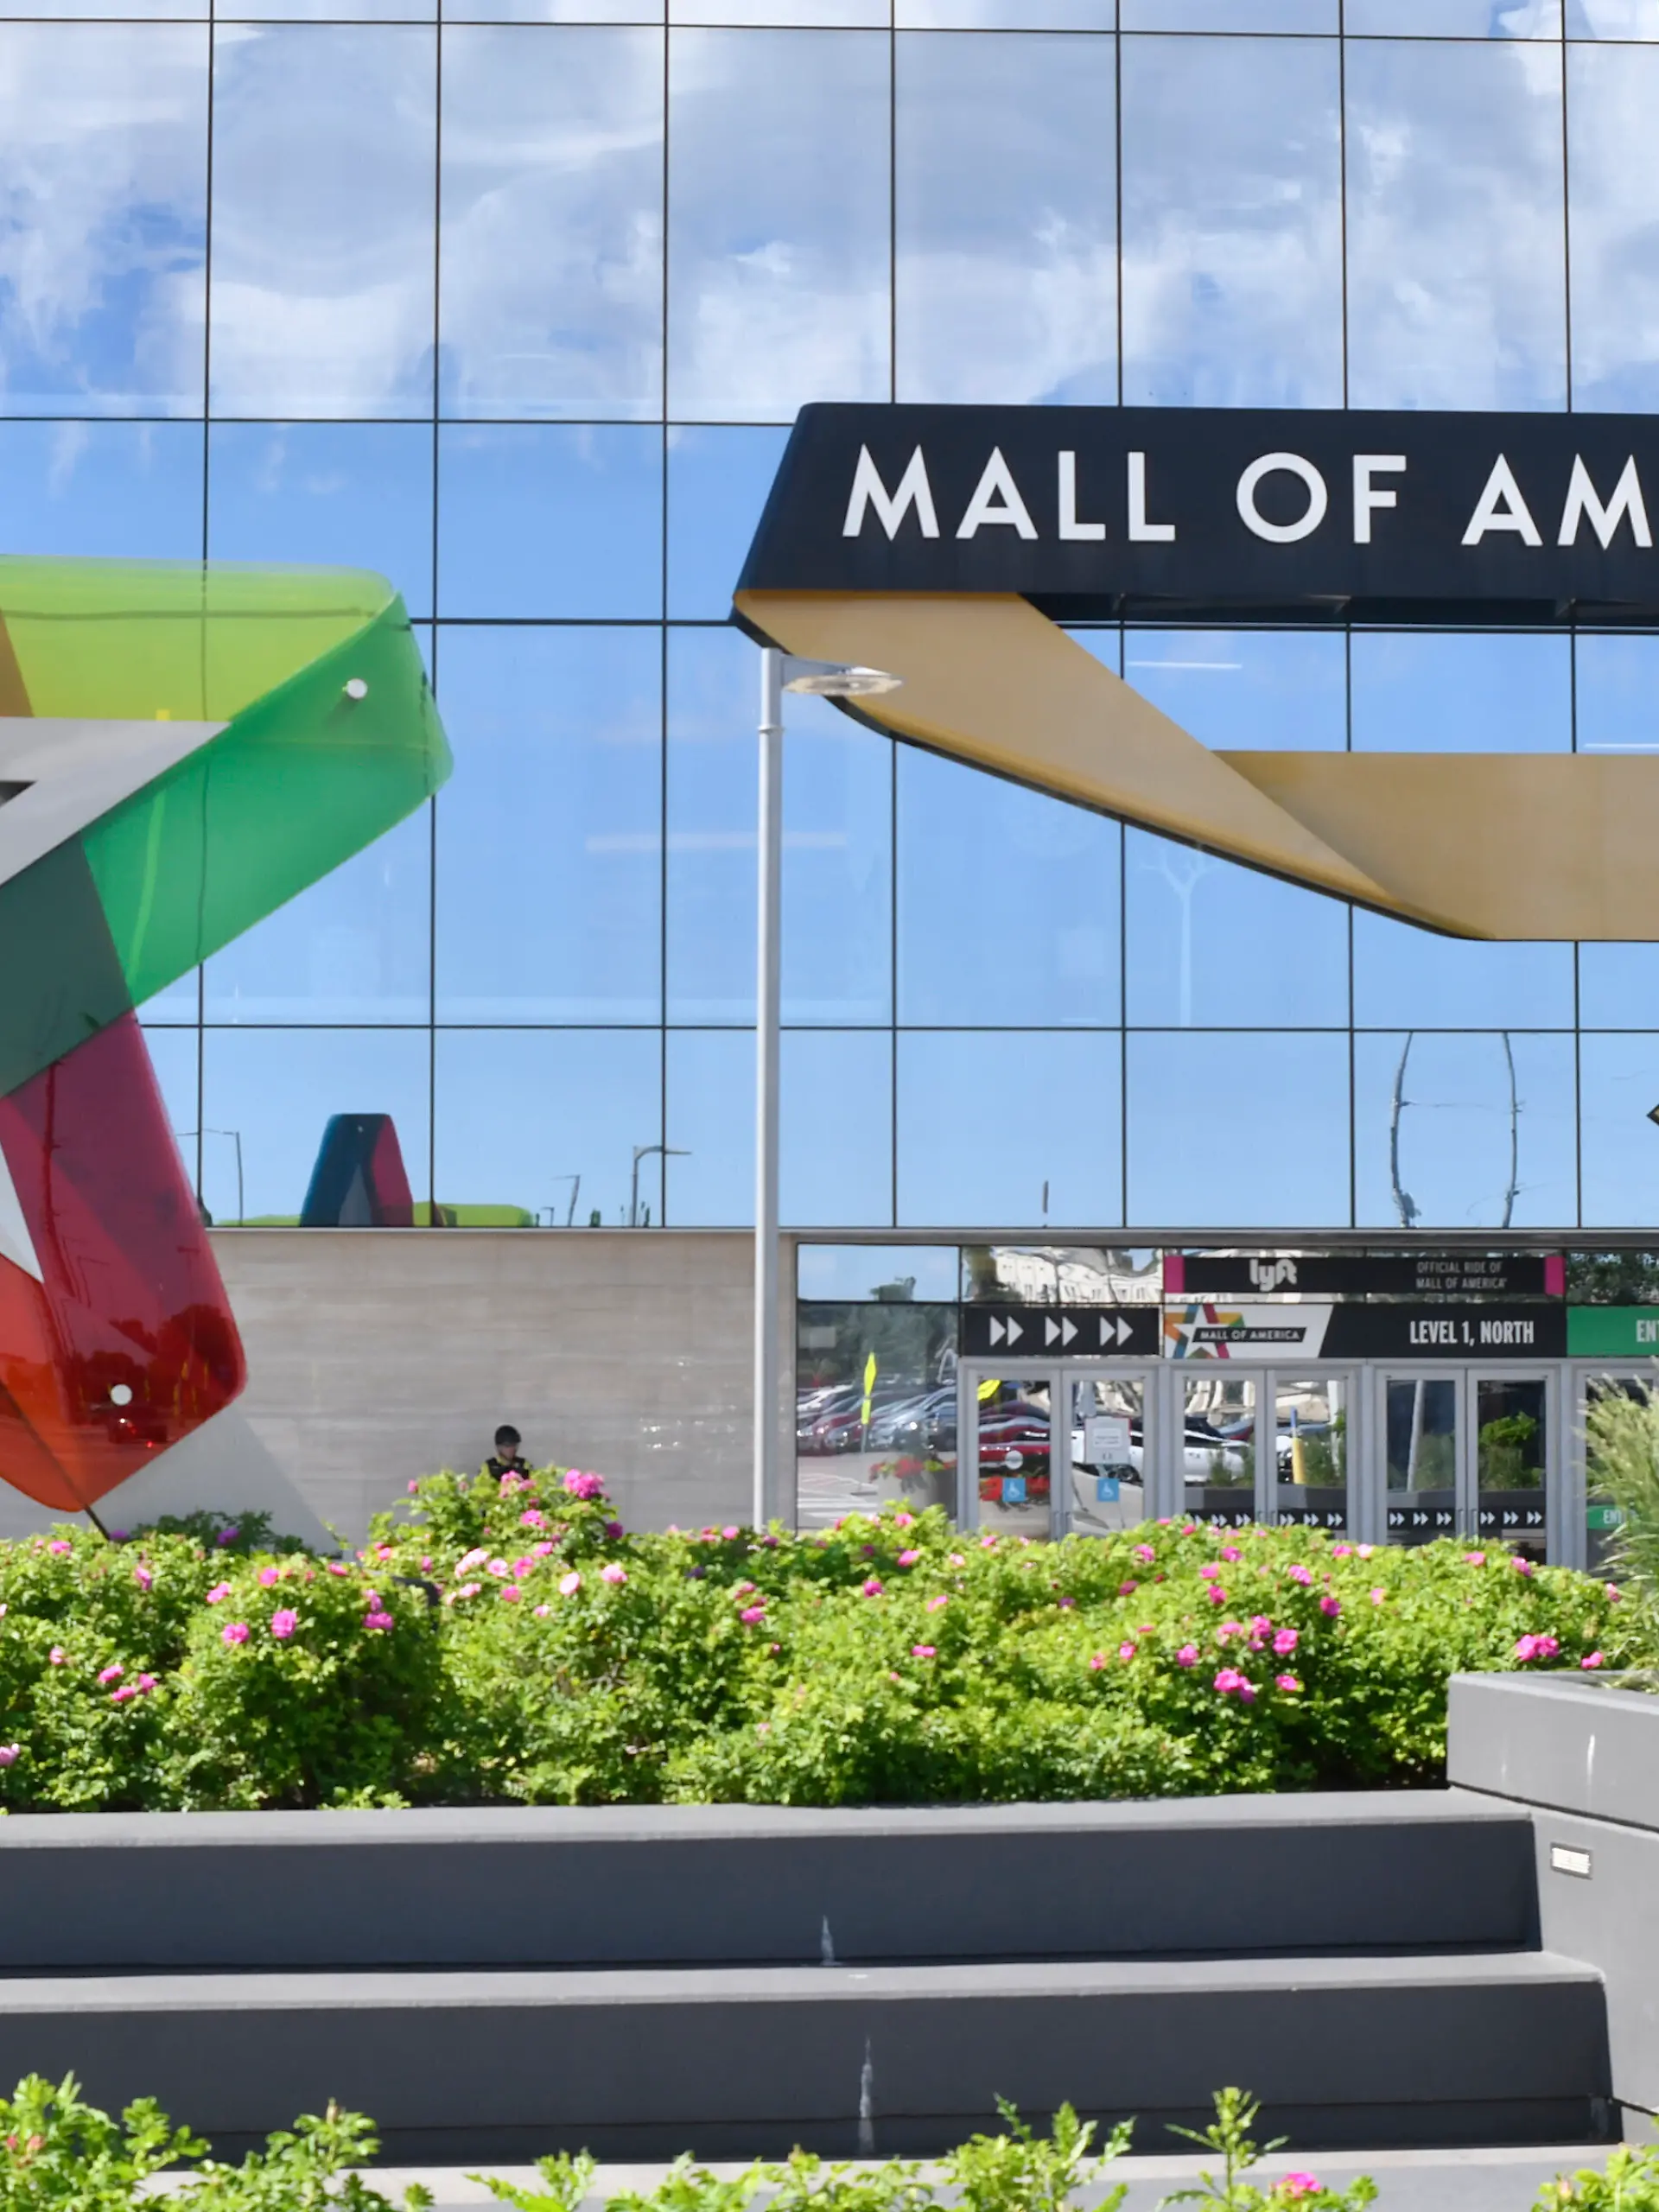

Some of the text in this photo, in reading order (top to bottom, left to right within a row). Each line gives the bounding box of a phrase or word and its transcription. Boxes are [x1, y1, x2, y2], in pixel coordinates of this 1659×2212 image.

[842, 443, 1176, 542] MALL
[1236, 452, 1407, 543] OF
[1249, 1258, 1298, 1292] lyft
[1416, 1262, 1503, 1274] OFFICIAL RIDE OF
[1415, 1277, 1442, 1289] MALL
[1445, 1277, 1459, 1289] OF
[1200, 1330, 1300, 1340] MALL OF AMERICA
[1409, 1320, 1535, 1347] LEVEL 1, NORTH
[1637, 1319, 1659, 1343] EN
